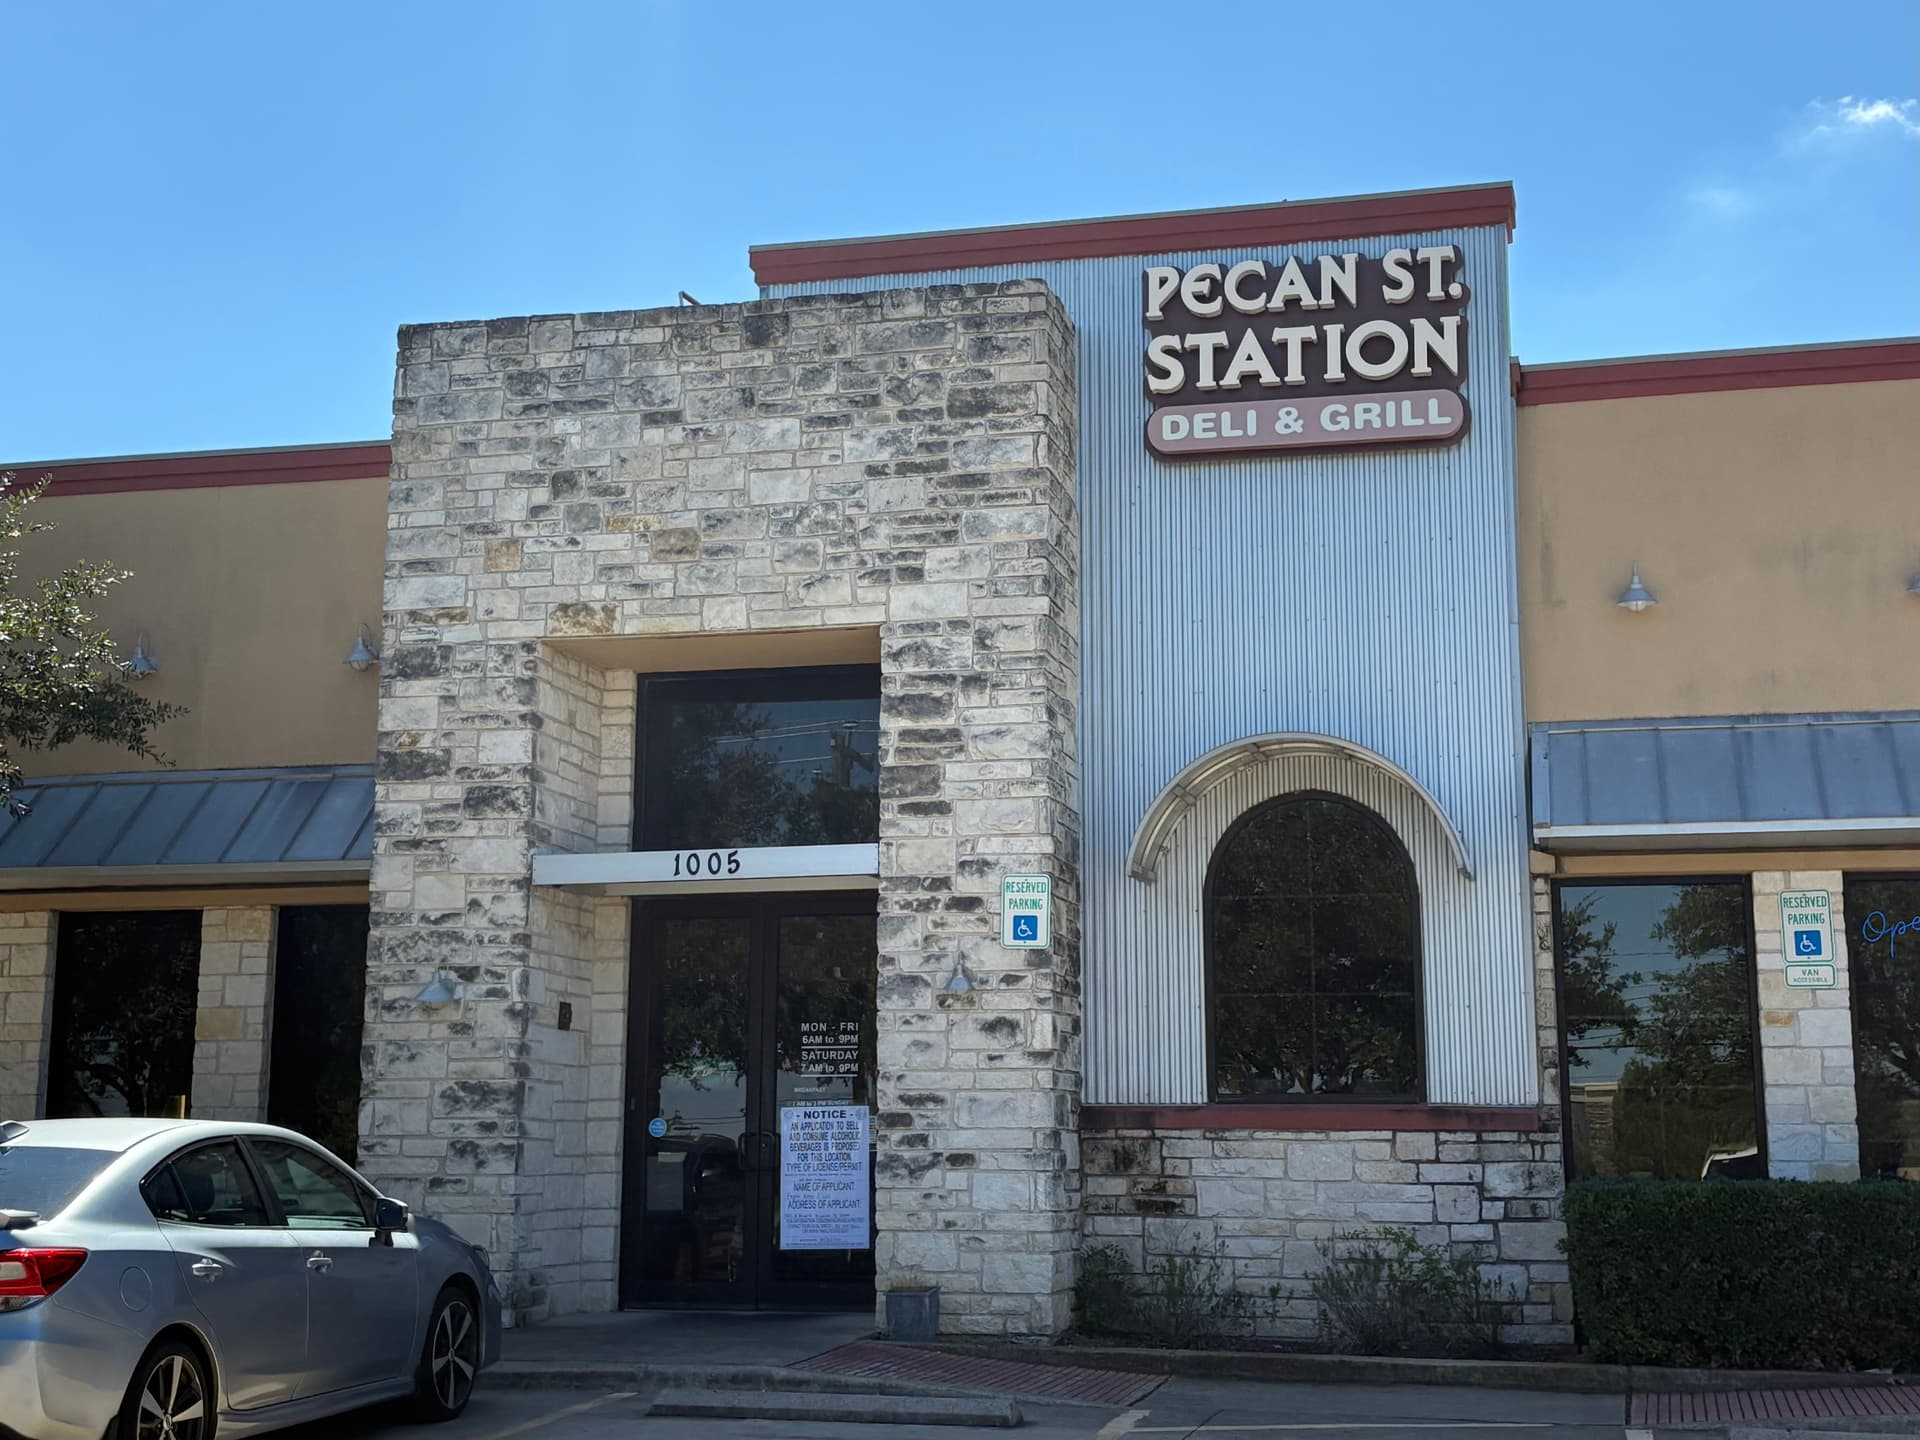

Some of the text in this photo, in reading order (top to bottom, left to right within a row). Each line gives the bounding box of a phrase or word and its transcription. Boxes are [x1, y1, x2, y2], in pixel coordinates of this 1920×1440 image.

[1145, 245, 1463, 321] PECAN ST.
[1147, 316, 1461, 394] STATION
[1161, 398, 1452, 441] DELI & GRILL
[673, 850, 741, 877] 1005
[1005, 881, 1047, 893] RESERVED
[1008, 898, 1044, 910] PARKING
[1783, 896, 1827, 908] RESERVED
[1787, 912, 1825, 925] PARKING
[1801, 968, 1820, 976] VAN
[801, 1022, 827, 1032] MON
[840, 1022, 859, 1032] FRI
[802, 1034, 859, 1044] 6AM to 9PM
[801, 1050, 859, 1060] SATURDAY
[825, 1063, 834, 1072] to
[838, 1063, 859, 1072] 9PM
[803, 1110, 847, 1119] NOTICE
[791, 1120, 860, 1131] AN APPLICATION TO SELL
[789, 1131, 860, 1141] AND CONSUME ALCOHOLIC
[789, 1141, 860, 1152] BEVERAGES IS PROPOSED
[797, 1152, 808, 1162] FOR
[811, 1152, 823, 1162] THIS
[786, 1162, 802, 1172] TYPE
[803, 1162, 812, 1172] OF
[793, 1182, 812, 1192] NAME
[812, 1182, 821, 1192] OF
[787, 1200, 817, 1209] ADDRESS
[817, 1199, 826, 1209] OF
